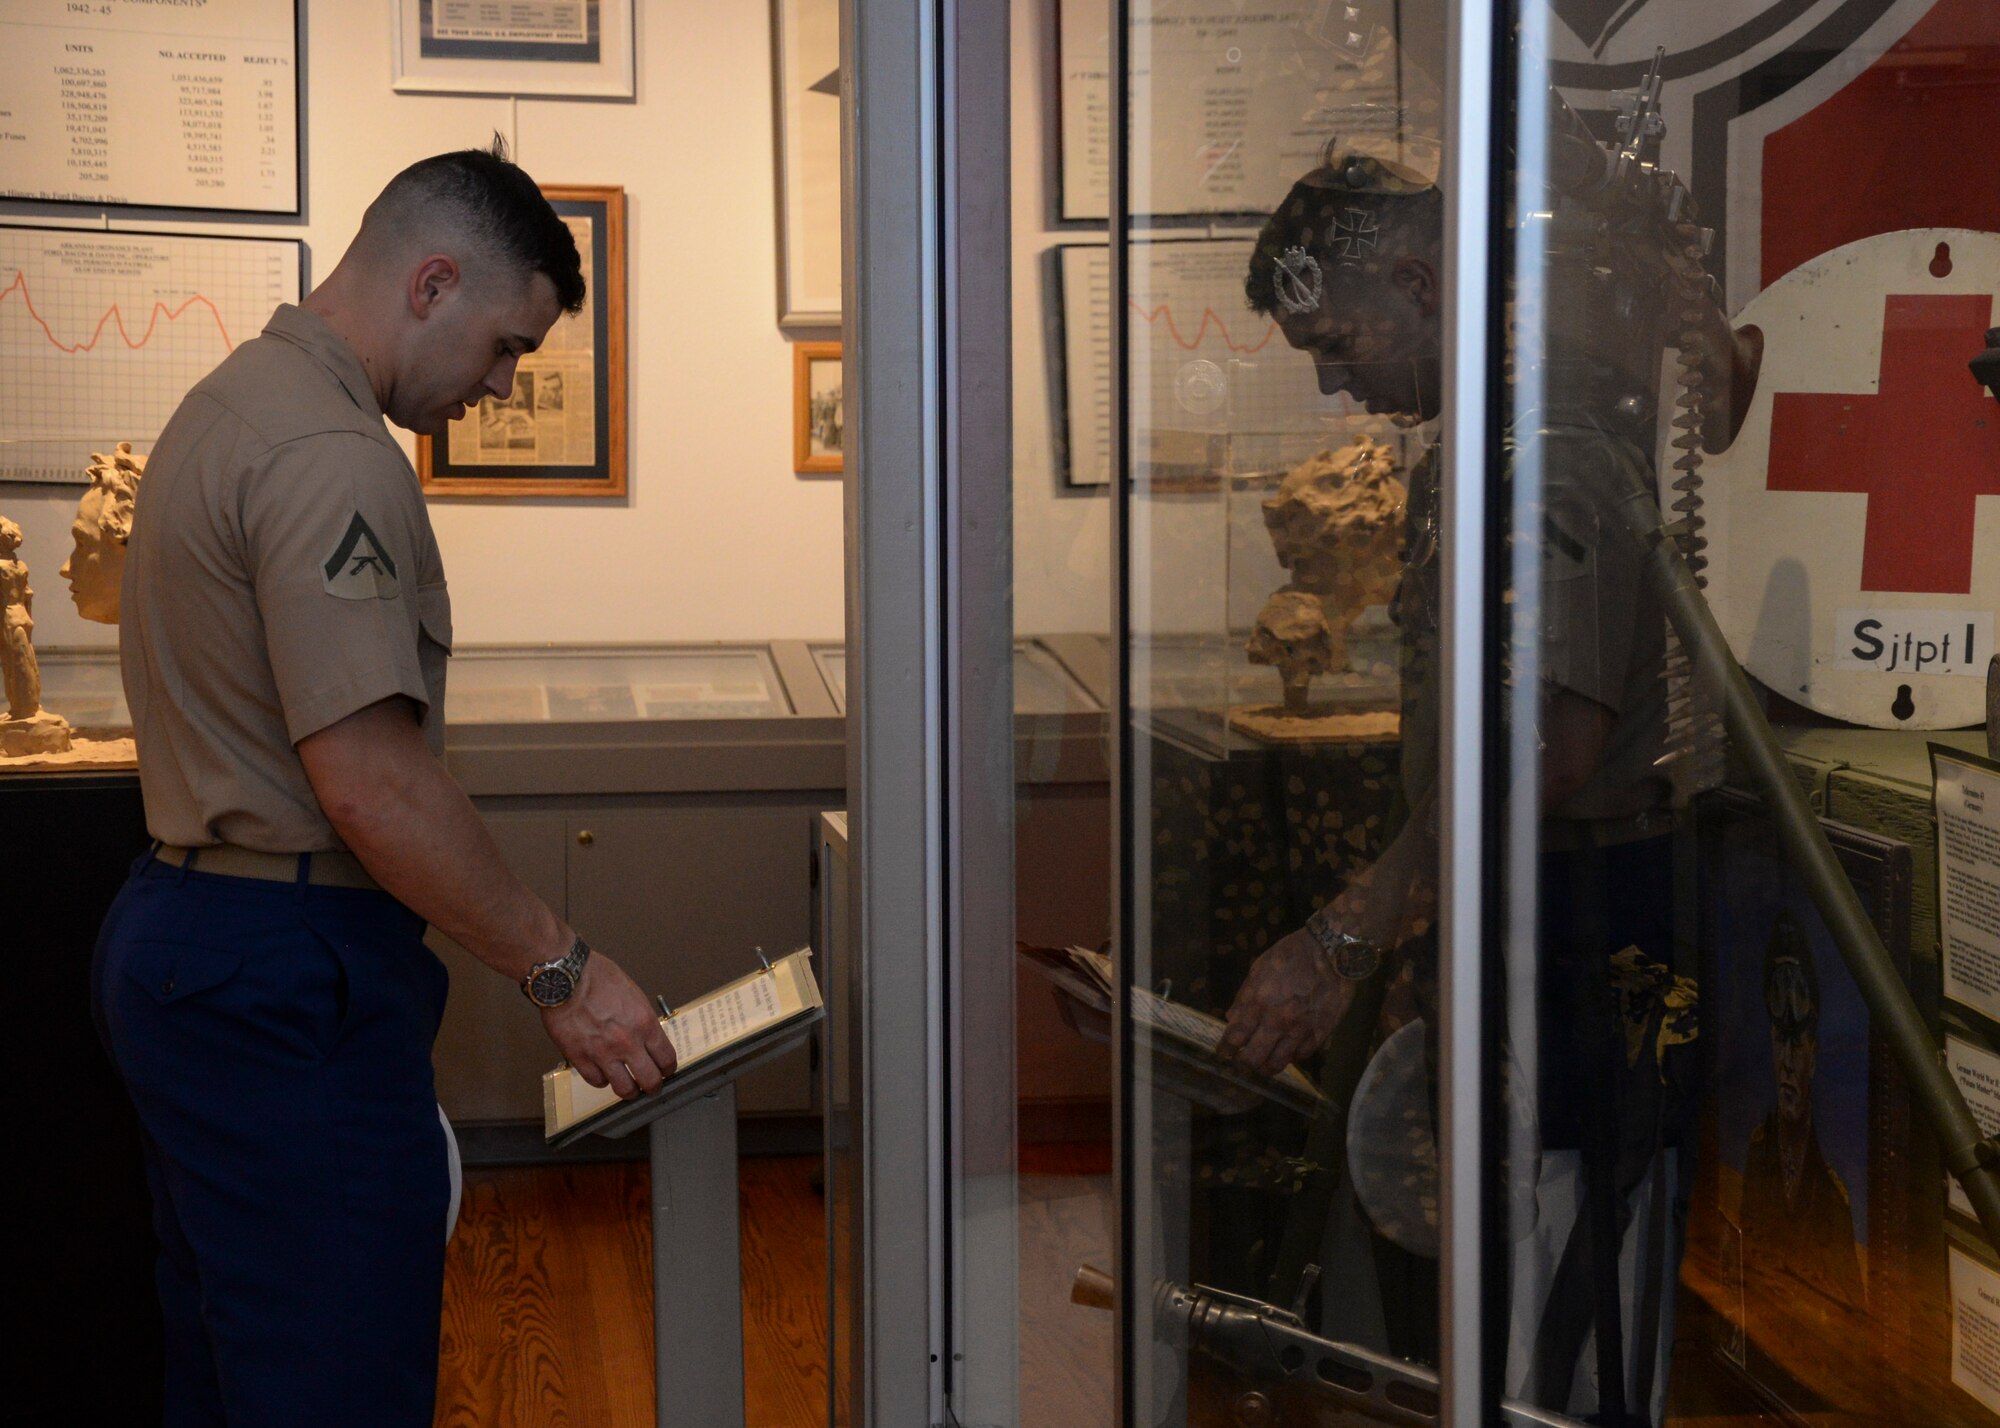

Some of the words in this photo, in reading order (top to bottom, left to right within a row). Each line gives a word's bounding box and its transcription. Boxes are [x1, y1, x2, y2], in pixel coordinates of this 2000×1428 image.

[67, 3, 90, 13] 1942
[100, 5, 112, 15] 45
[65, 44, 94, 53] UNITS
[177, 52, 226, 62] ACCEPTED
[243, 55, 278, 65] REJECT
